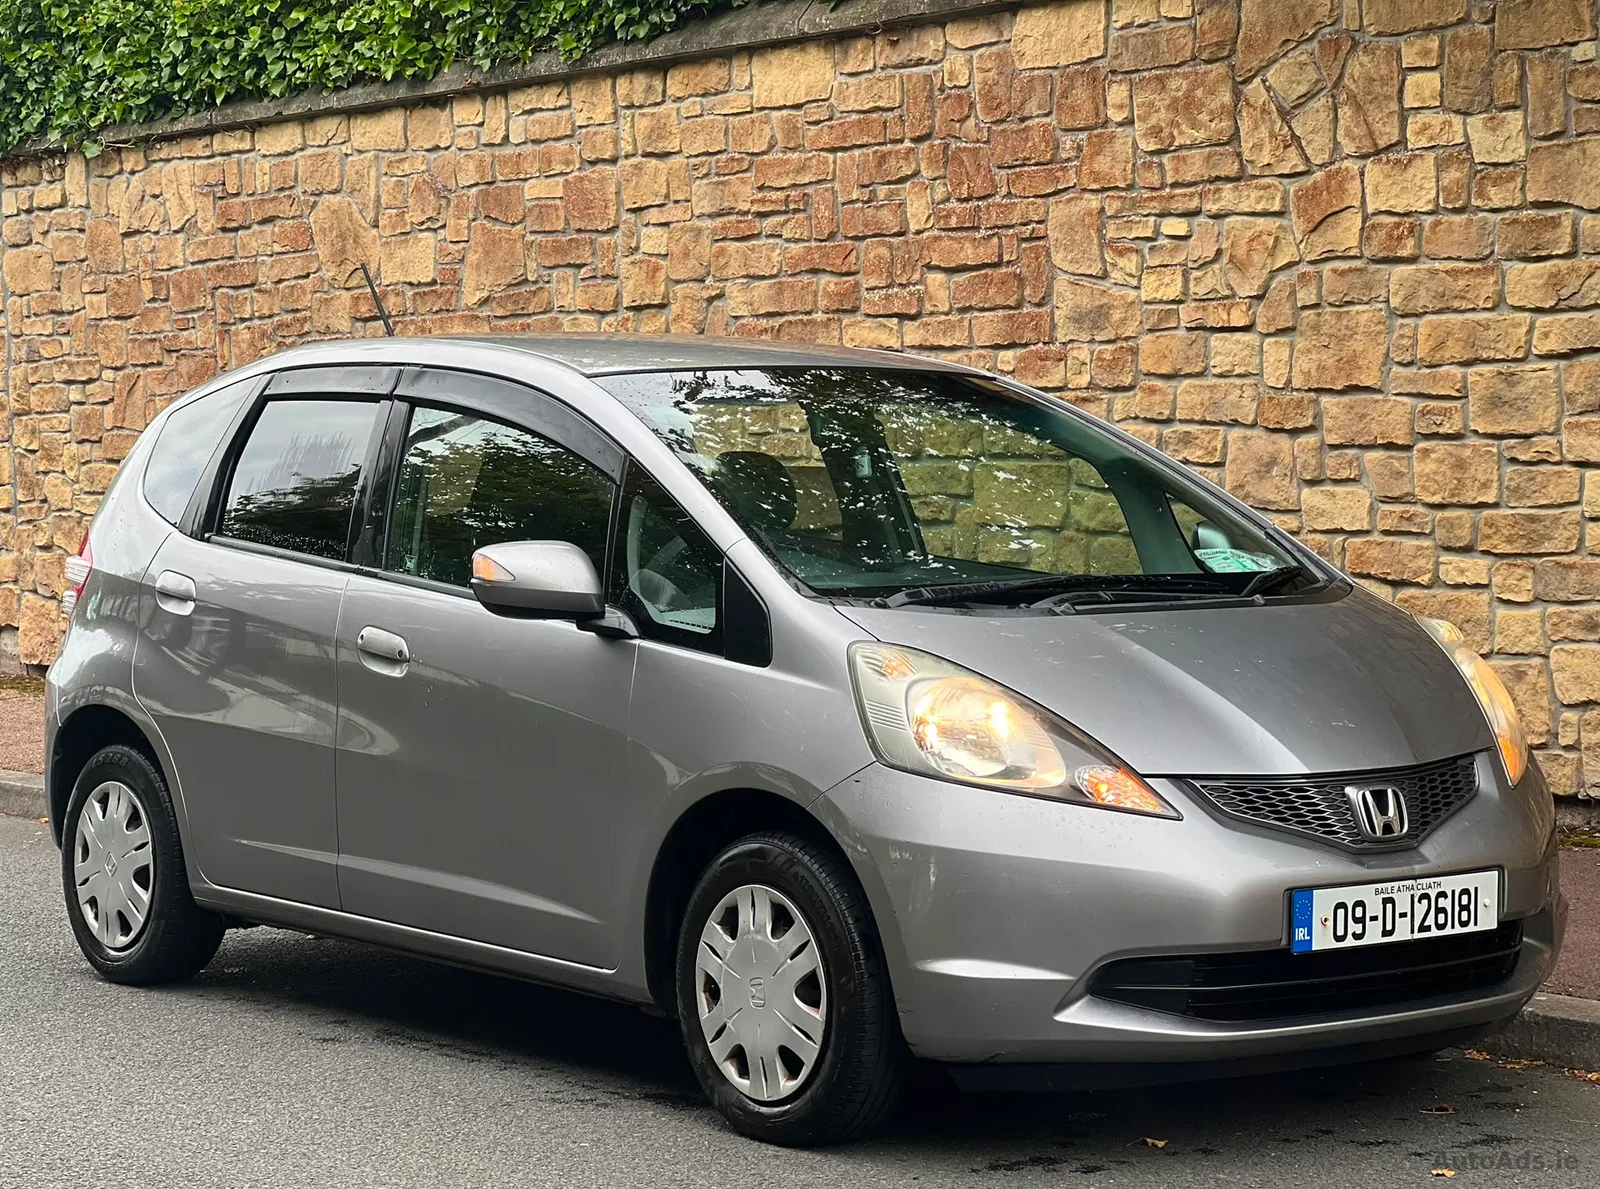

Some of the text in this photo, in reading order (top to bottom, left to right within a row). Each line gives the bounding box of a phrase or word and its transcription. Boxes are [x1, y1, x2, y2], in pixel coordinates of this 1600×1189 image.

[1375, 886, 1395, 896] BAILE
[1416, 881, 1442, 891] CLIATH
[1332, 886, 1479, 943] 09-D-126181
[1295, 927, 1310, 941] IRL
